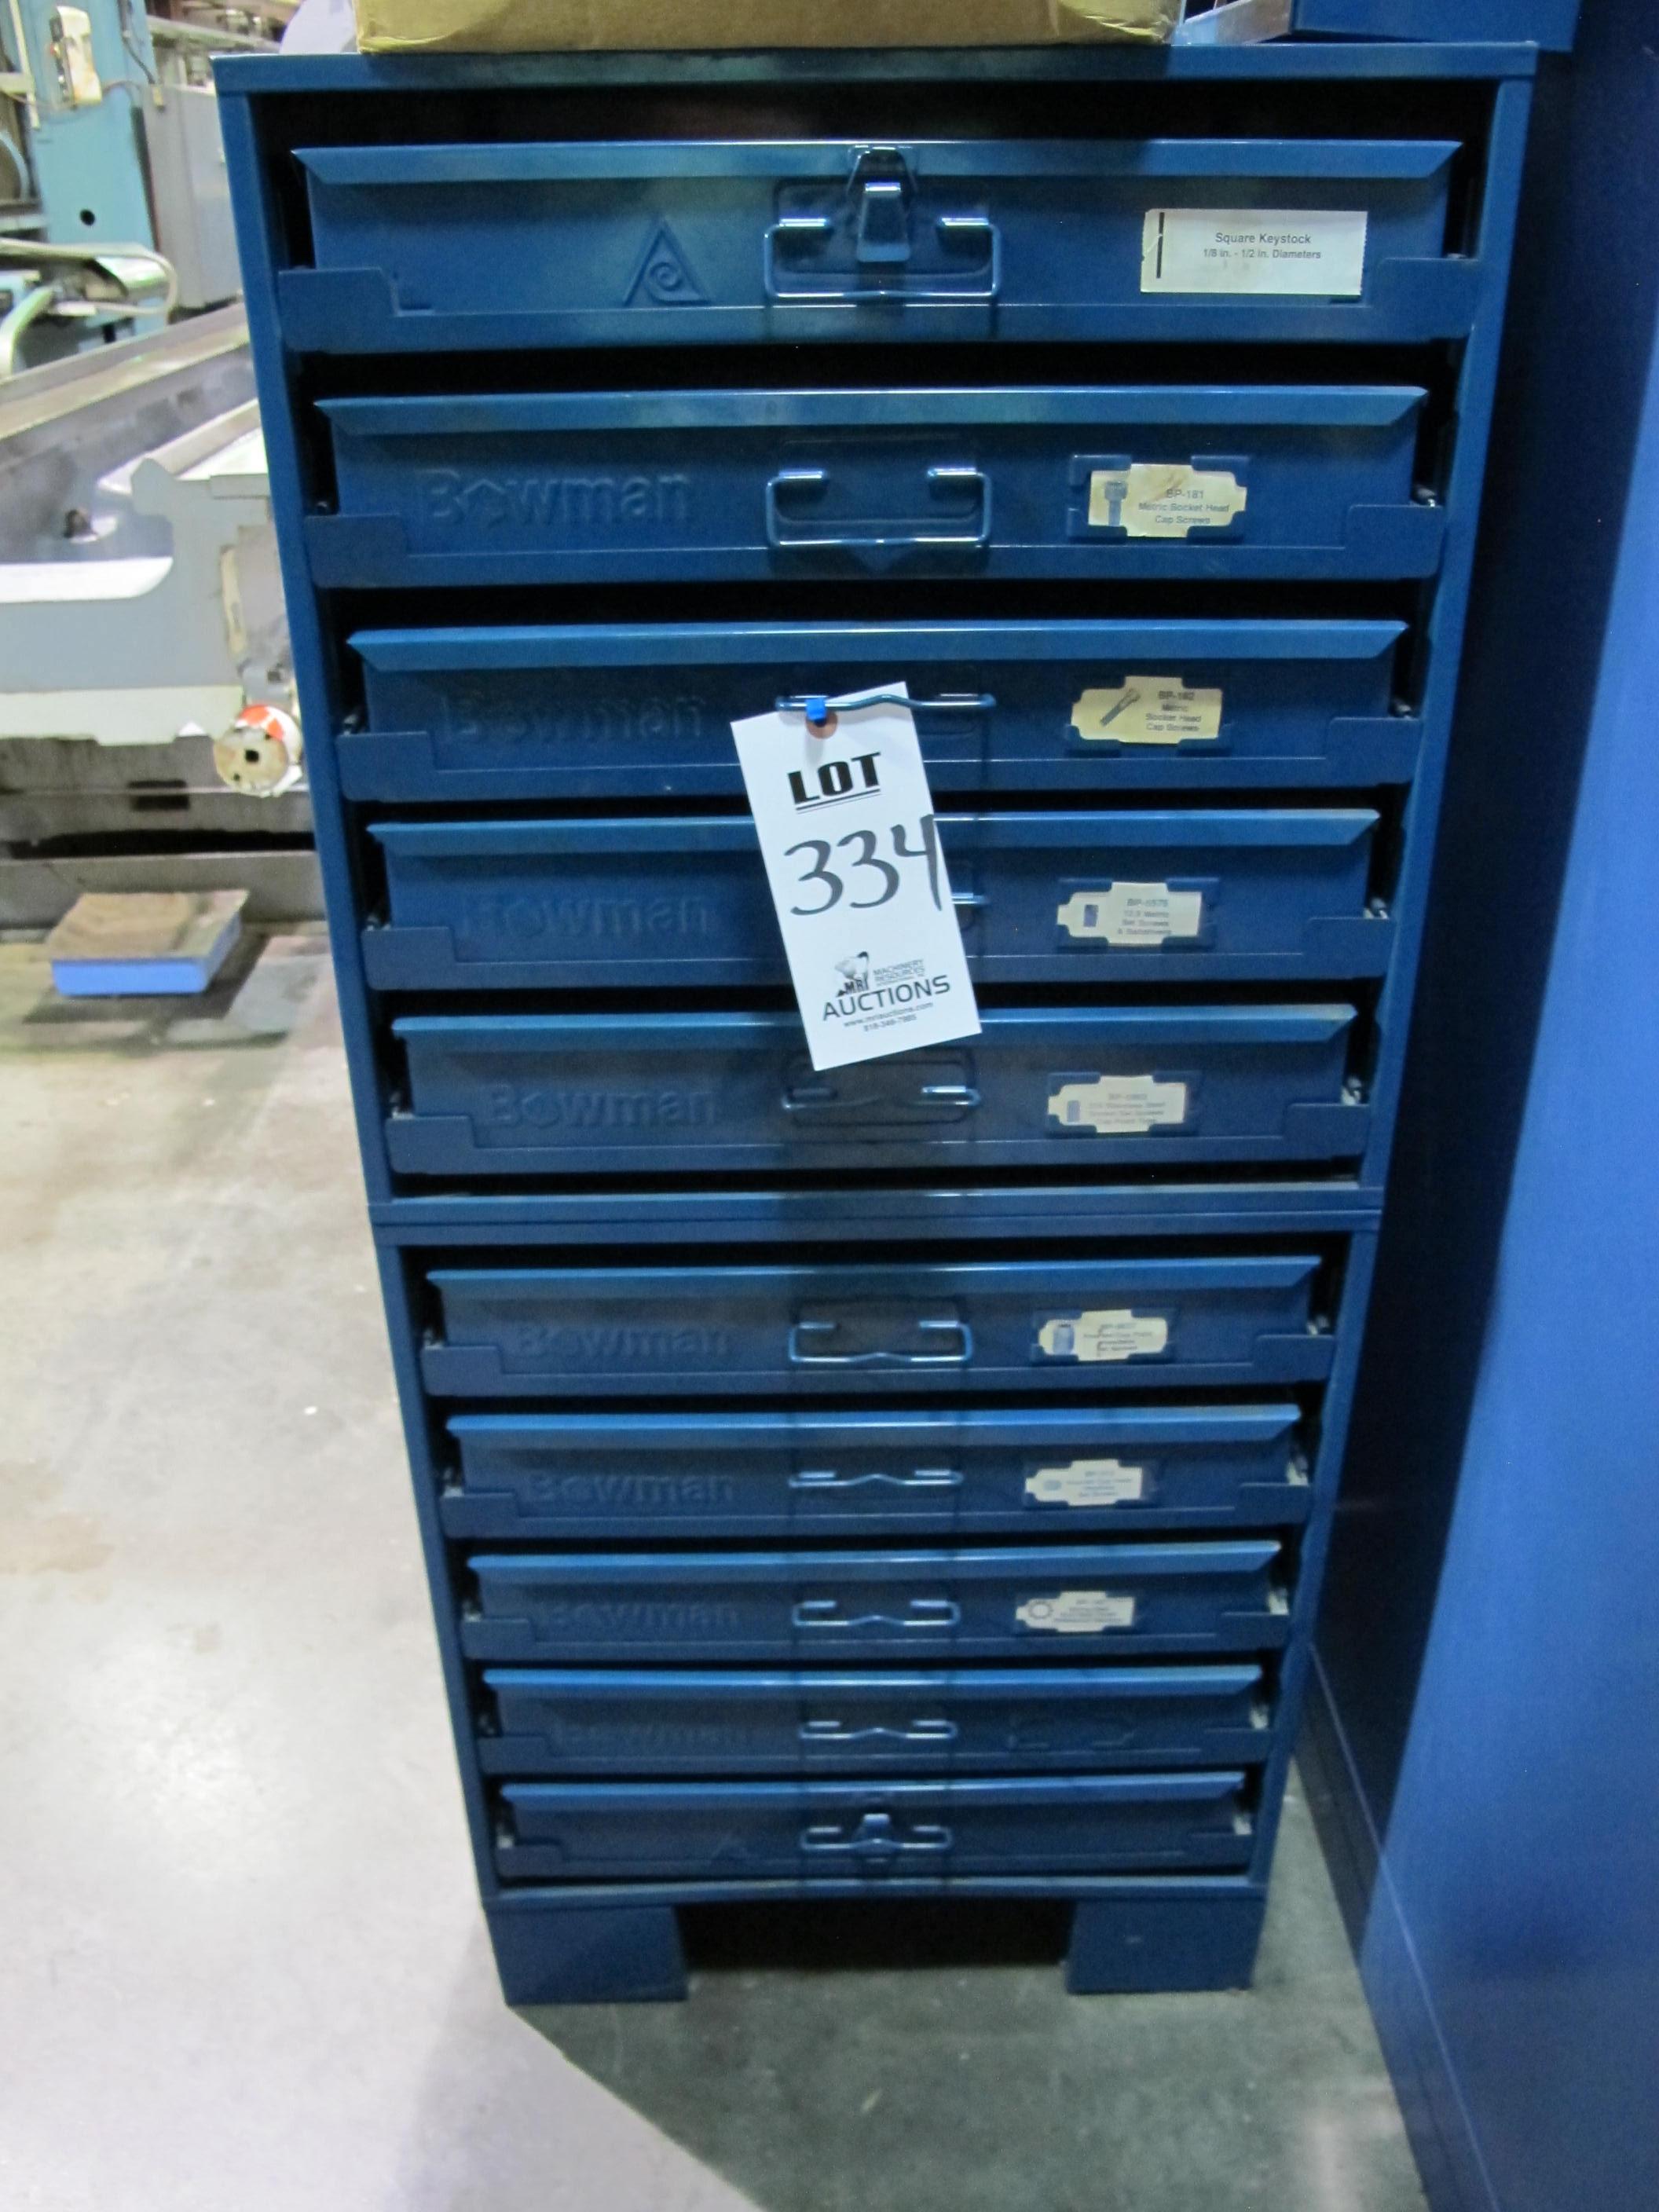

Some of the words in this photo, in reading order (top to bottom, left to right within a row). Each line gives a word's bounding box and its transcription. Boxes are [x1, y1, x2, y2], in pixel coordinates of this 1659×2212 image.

[1203, 249, 1218, 258] 1/8
[1220, 249, 1232, 258] in.
[1242, 249, 1254, 258] 1/2
[1258, 249, 1269, 258] in.
[1273, 250, 1321, 259] Diameters
[1215, 233, 1255, 244] Square
[1259, 233, 1311, 245] Keystock
[415, 468, 690, 526] Bowman
[787, 752, 881, 805] LOT
[783, 814, 943, 917] 334
[823, 974, 951, 1022] AUCTIONS
